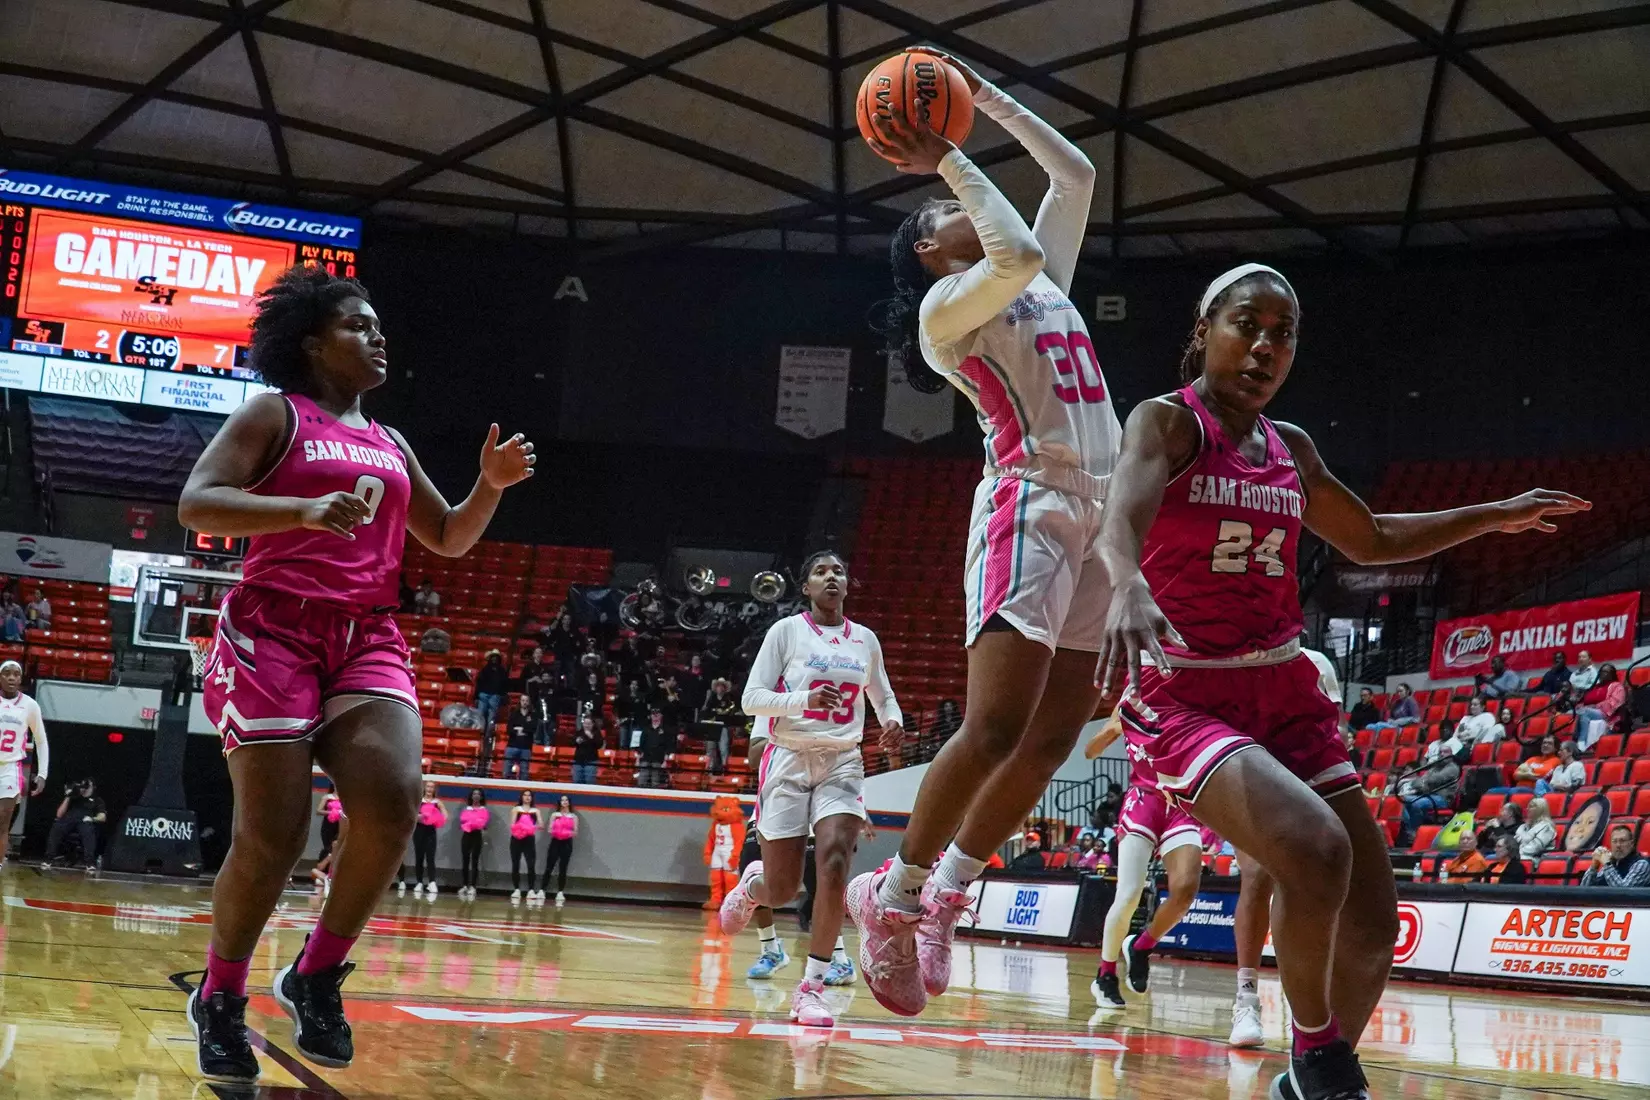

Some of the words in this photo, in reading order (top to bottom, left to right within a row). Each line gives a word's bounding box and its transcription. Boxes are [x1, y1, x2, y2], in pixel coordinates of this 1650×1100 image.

[0, 179, 41, 196] BUD
[40, 184, 111, 205] LIGHT
[5, 204, 25, 217] PTS
[117, 202, 146, 213] DRINK
[149, 207, 215, 222] RESPONSIBLY.
[126, 195, 149, 204] STAY
[163, 201, 180, 209] THE
[182, 203, 209, 213] GAME.
[15, 221, 23, 232] 0
[232, 210, 285, 229] BUD
[285, 217, 354, 239] LIGHT
[13, 236, 22, 249] 0
[92, 227, 117, 238] SAM
[119, 230, 172, 246] HOUSTON
[186, 238, 201, 249] LA
[203, 242, 233, 253] TECH
[10, 252, 20, 265] 0
[54, 232, 266, 297] GAMEDAY
[302, 245, 319, 257] PLY
[323, 248, 334, 260] FL
[336, 250, 355, 263] PTS
[8, 267, 18, 281] 2
[5, 283, 16, 297] 0
[553, 276, 588, 302] A
[1096, 296, 1126, 321] B
[94, 329, 111, 349] 2
[132, 335, 178, 358] 5:06
[213, 344, 229, 364] 7
[73, 349, 91, 359] TOL
[95, 352, 102, 360] 4
[149, 357, 166, 367] 1ST
[197, 364, 214, 375] TOL
[218, 368, 225, 376] 4
[1034, 330, 1106, 405] 30
[47, 375, 137, 399] HERMANN
[49, 365, 138, 388] MEMORIAL
[177, 379, 213, 391] FIRST
[161, 386, 226, 401] FINANCIAL
[174, 397, 210, 408] BANK
[303, 439, 348, 463] SAM
[353, 473, 385, 525] 0
[1188, 474, 1237, 507] SAM
[1210, 519, 1287, 577] 24
[1499, 624, 1568, 654] CANIAC
[1571, 614, 1629, 644] CREW
[803, 679, 860, 725] 23
[125, 826, 193, 840] HERMANN
[126, 817, 194, 835] MEMORIAL
[1015, 890, 1039, 907] BUD
[1006, 907, 1040, 926] LIGHT
[1500, 908, 1633, 942] ARTECH
[1493, 940, 1529, 951] SIGNS
[1530, 943, 1539, 952] &
[1541, 943, 1601, 957] LIGHTING,
[1602, 947, 1628, 958] INC.
[1501, 959, 1609, 979] 936.435.9966
